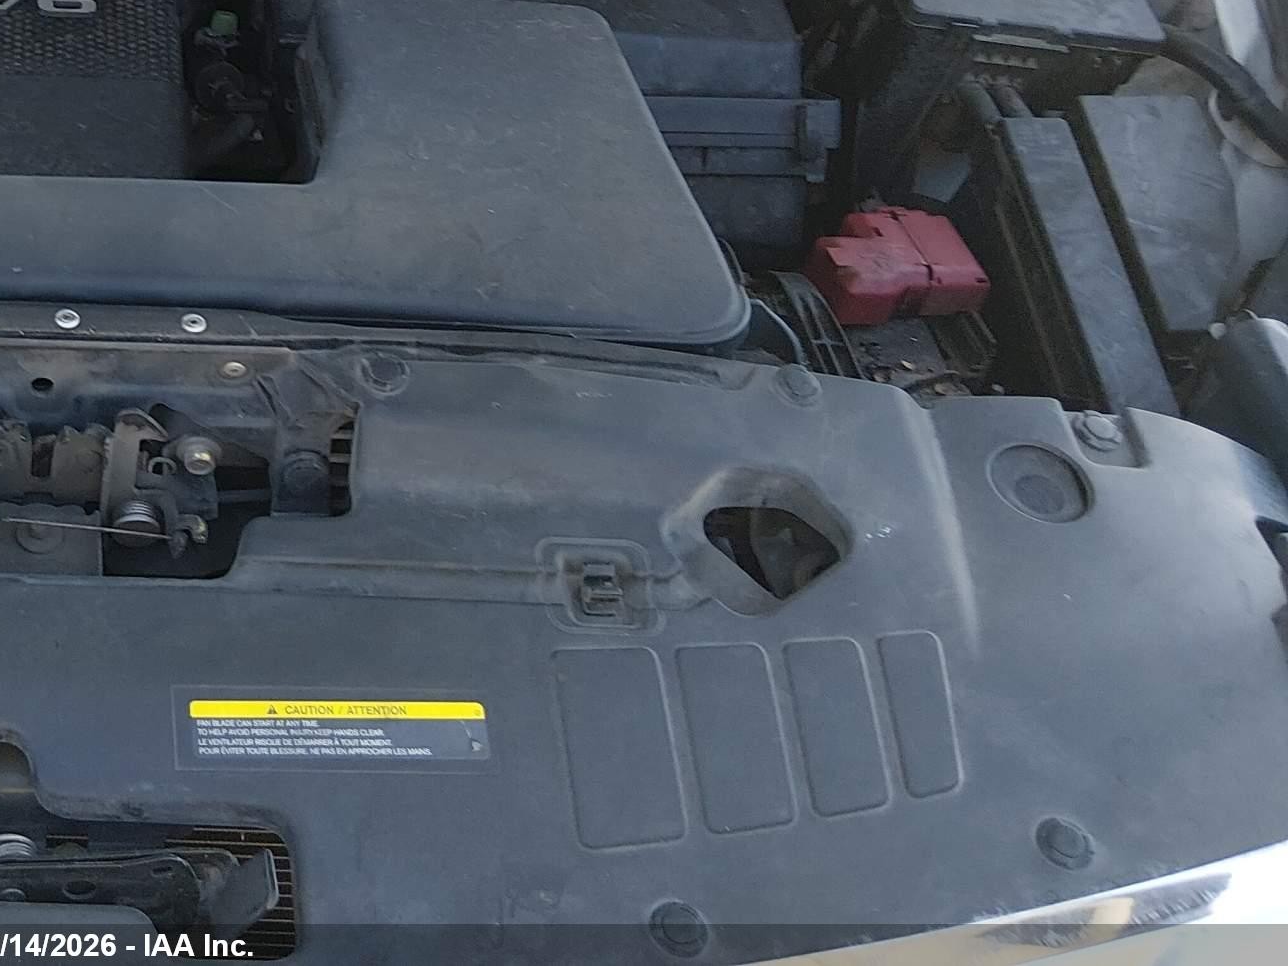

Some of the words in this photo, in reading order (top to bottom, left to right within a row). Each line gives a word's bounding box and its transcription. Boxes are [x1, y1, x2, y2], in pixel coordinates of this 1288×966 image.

[284, 705, 335, 715] CAUTION
[347, 705, 408, 716] ATTENTION
[196, 719, 211, 727] FAN
[211, 719, 235, 727] BLADE
[236, 719, 252, 727] CAN
[253, 719, 275, 727] START
[276, 719, 285, 727] AT
[285, 719, 301, 727] ANY
[197, 728, 208, 736] TO
[208, 728, 228, 736] HELP
[228, 728, 250, 736] AVOID
[250, 728, 289, 736] PERSONAL
[314, 728, 333, 736] KEEP
[333, 728, 359, 736] HANDS
[198, 738, 209, 746] LE
[208, 738, 254, 746] VENTILATEUR
[254, 738, 282, 746] RISQUE
[282, 738, 292, 746] DE
[293, 736, 334, 746] DÉMARRER
[340, 738, 359, 746] TOUT
[198, 747, 220, 755] POUR
[220, 746, 245, 755] ÉVITER
[245, 747, 269, 755] TOUTE
[309, 747, 320, 755] NE
[320, 747, 336, 755] PAS
[336, 747, 348, 755] EN
[348, 747, 393, 755] APPROCHER
[393, 747, 407, 755] LES
